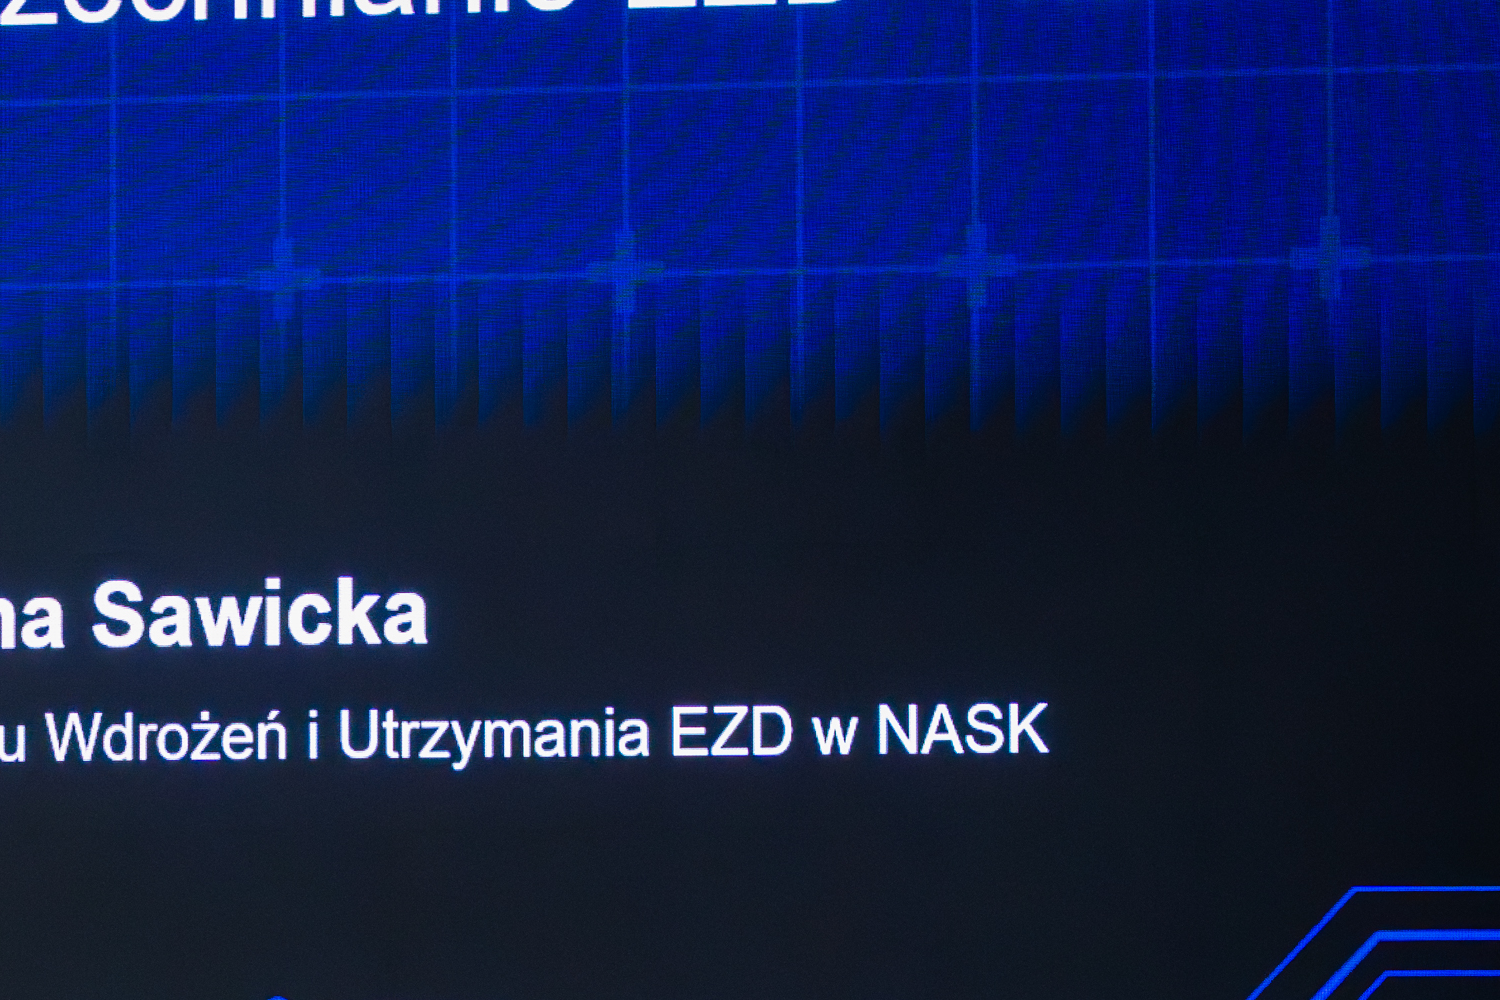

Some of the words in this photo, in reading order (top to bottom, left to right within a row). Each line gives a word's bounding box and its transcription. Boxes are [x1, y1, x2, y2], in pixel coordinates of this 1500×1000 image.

[91, 576, 428, 649] Sawicka
[44, 710, 287, 762] Wdrożeń
[309, 709, 318, 760] i
[340, 706, 650, 771] Utrzymania
[672, 705, 793, 757] EZD
[811, 716, 859, 756] w
[879, 702, 1050, 755] NASK
